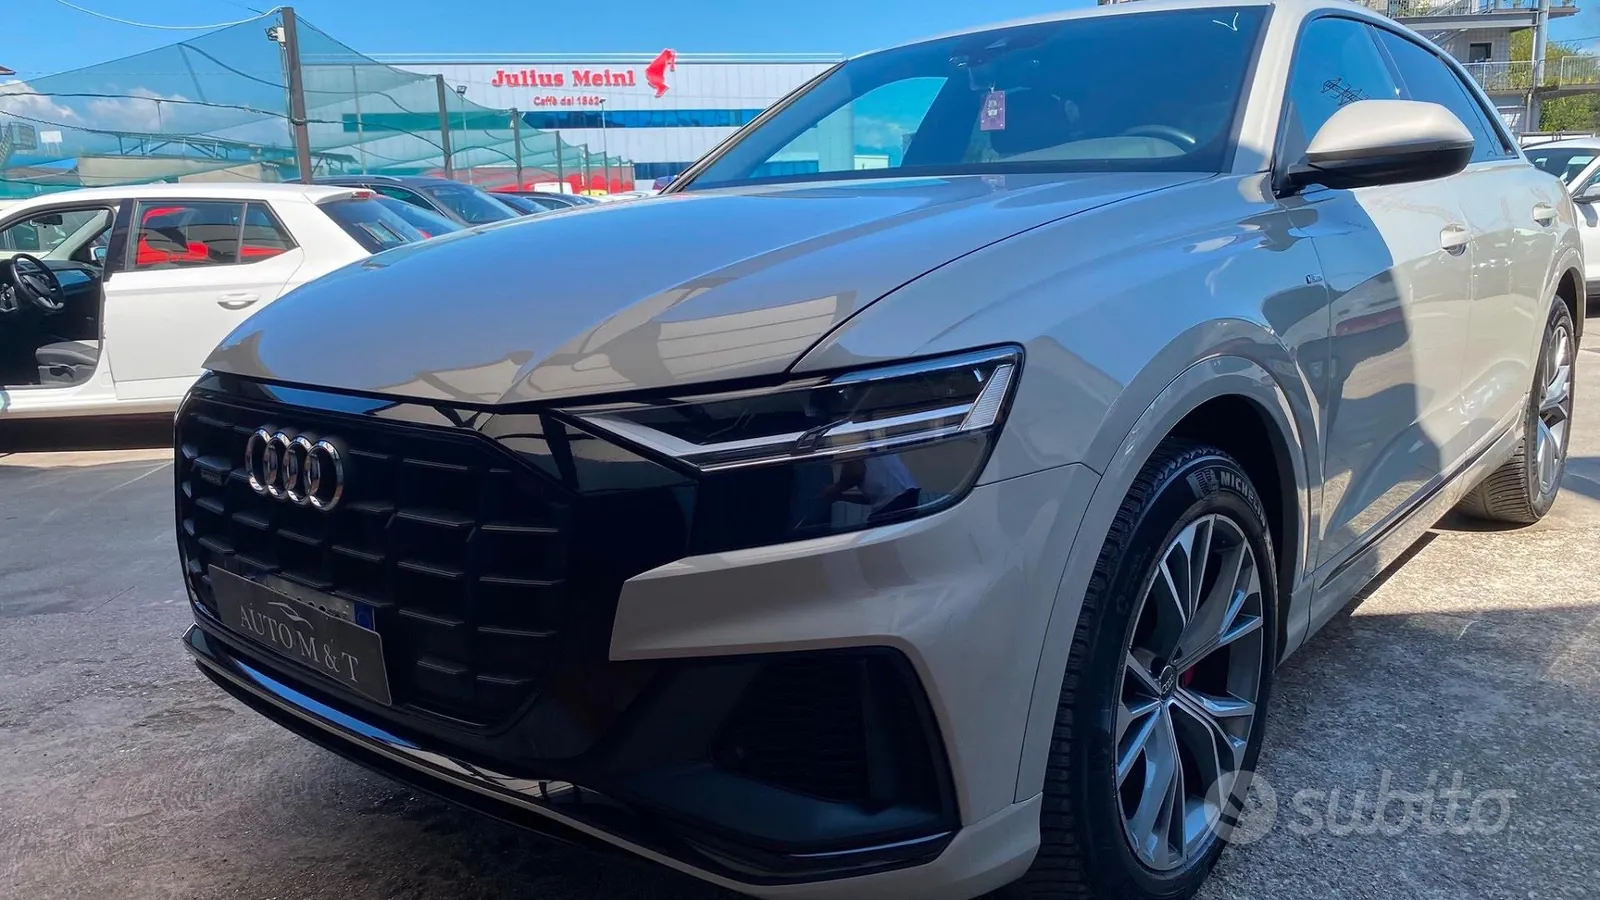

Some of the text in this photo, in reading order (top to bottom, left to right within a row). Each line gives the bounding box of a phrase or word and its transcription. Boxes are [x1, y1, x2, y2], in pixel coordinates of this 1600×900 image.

[492, 69, 637, 87] Julius Meinl
[560, 96, 574, 106] dal
[577, 96, 600, 106] 1862
